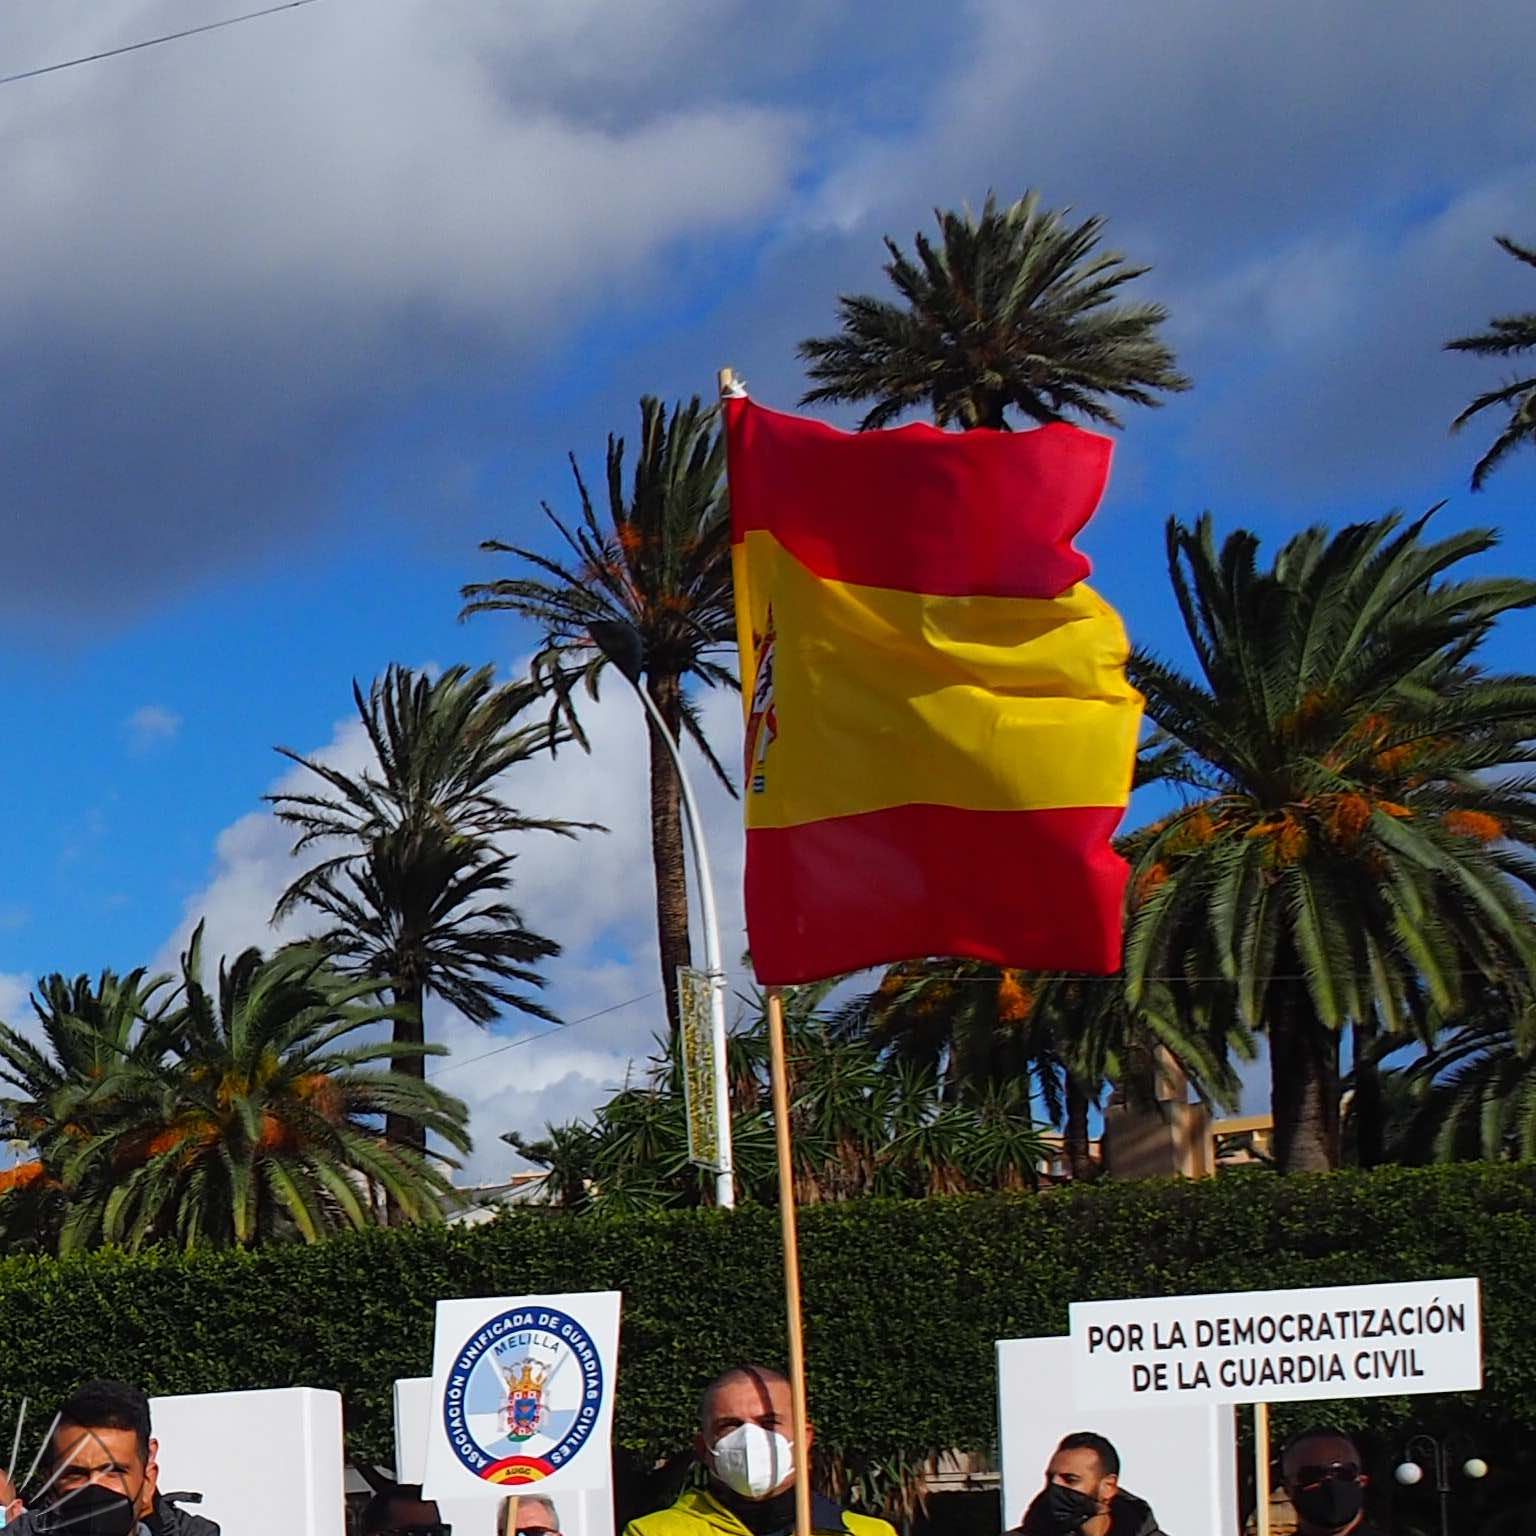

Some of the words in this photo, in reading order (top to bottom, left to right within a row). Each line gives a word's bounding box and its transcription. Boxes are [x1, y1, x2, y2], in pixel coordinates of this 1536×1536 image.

[459, 1313, 534, 1370] UNIFICADA
[494, 1333, 560, 1357] MELILLA
[538, 1313, 561, 1329] DE
[1088, 1322, 1144, 1353] POR
[1153, 1319, 1187, 1350] LA
[1194, 1296, 1467, 1348] DEMOCRATIZACIÓN
[561, 1324, 600, 1400] GUARDIAS
[1132, 1362, 1169, 1392] DE
[1178, 1359, 1211, 1389] LA
[1220, 1353, 1346, 1387] GUARDIA
[1354, 1348, 1425, 1380] CIVIL
[447, 1375, 489, 1469] ASOCIACIÓN
[550, 1406, 596, 1464] CIVILES
[504, 1467, 532, 1476] AUGC
